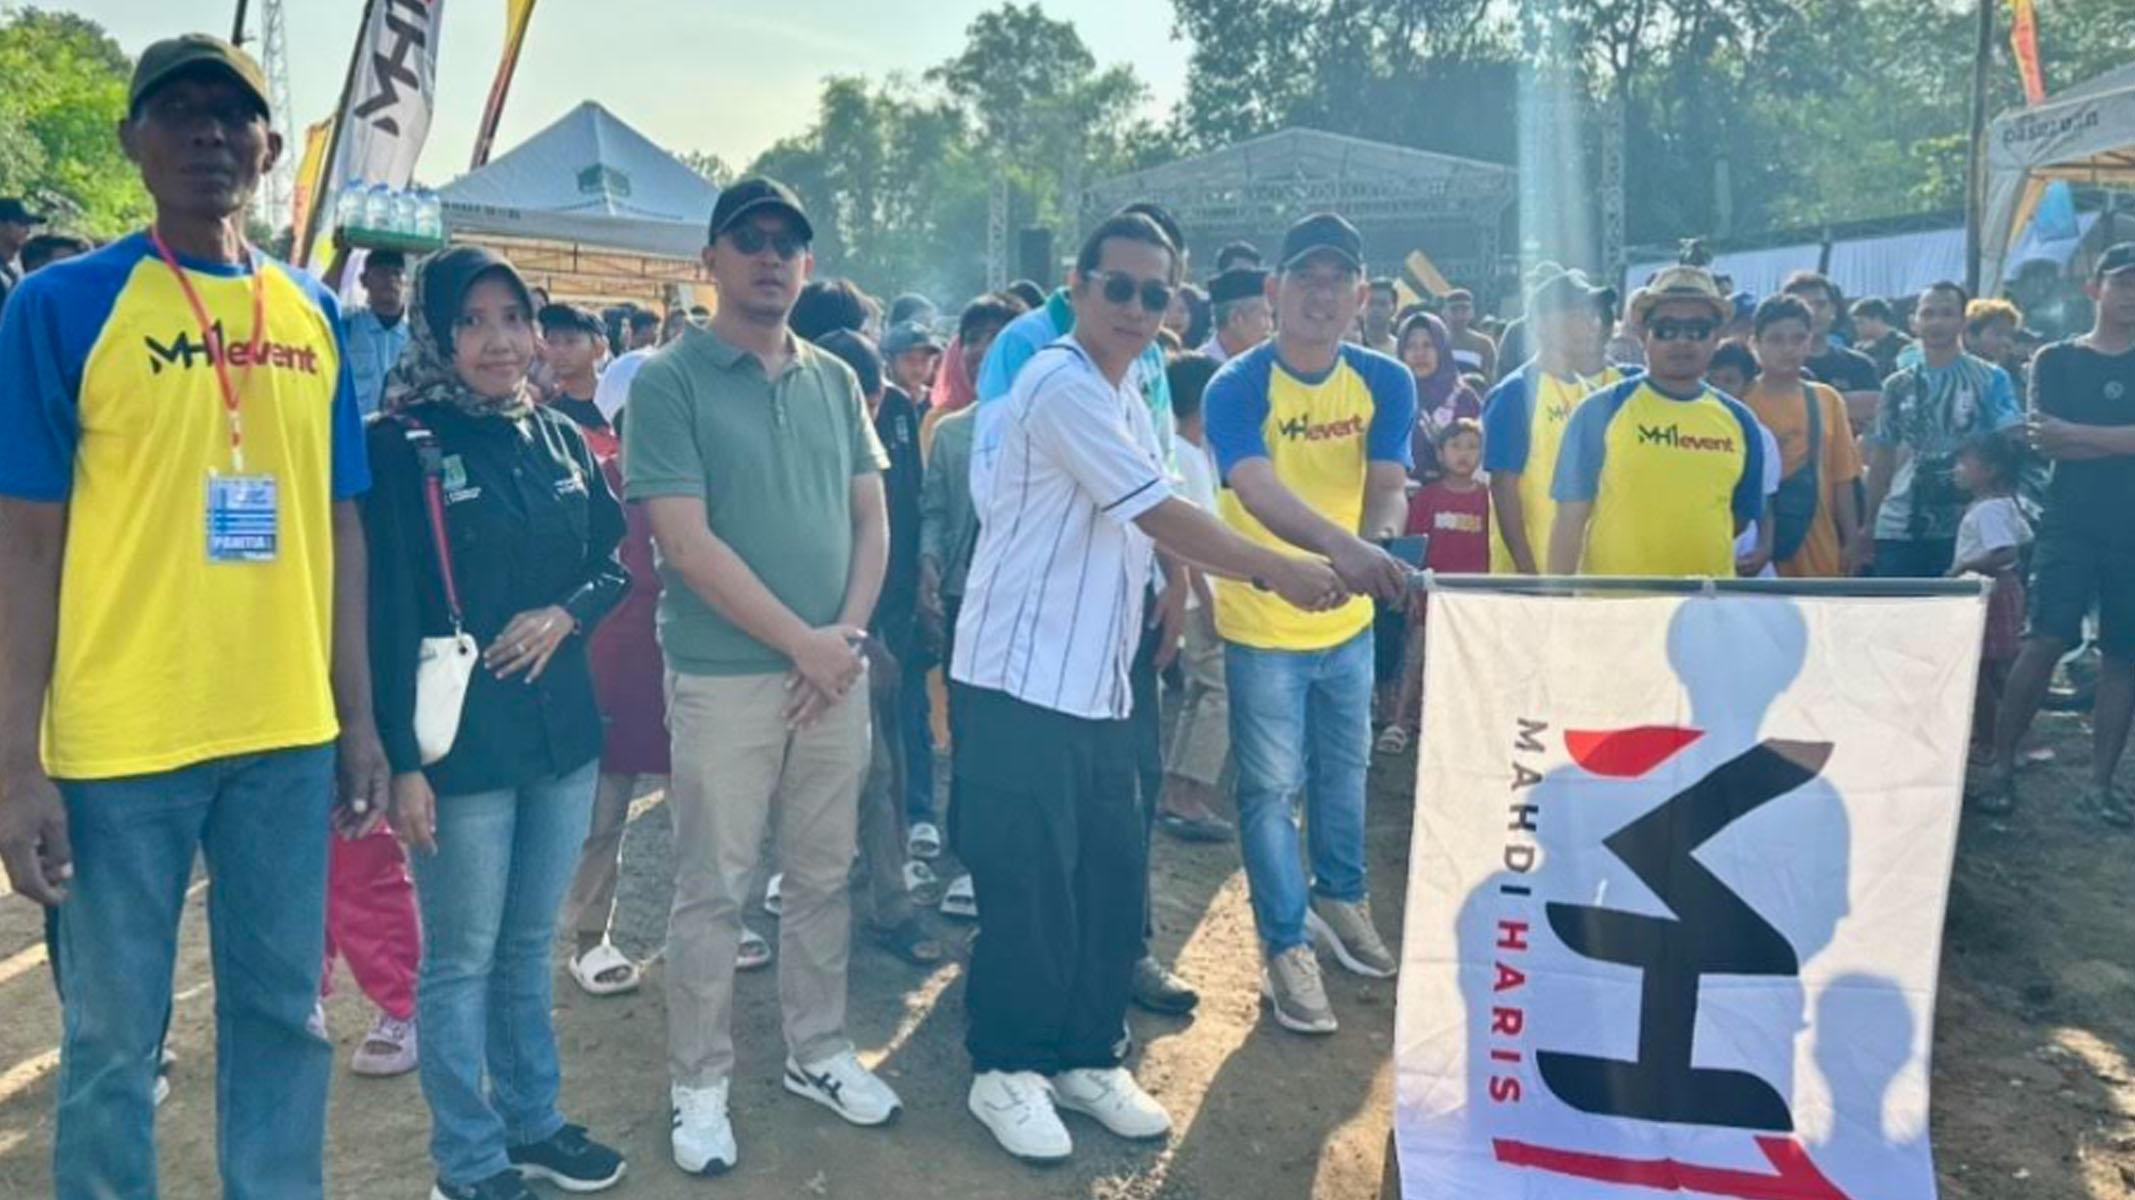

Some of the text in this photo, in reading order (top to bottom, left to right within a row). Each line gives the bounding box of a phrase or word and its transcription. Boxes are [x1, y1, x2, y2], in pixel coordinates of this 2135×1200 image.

[1637, 422, 1735, 453] MH1event
[1489, 717, 1549, 1103] MAHDI HARIS
